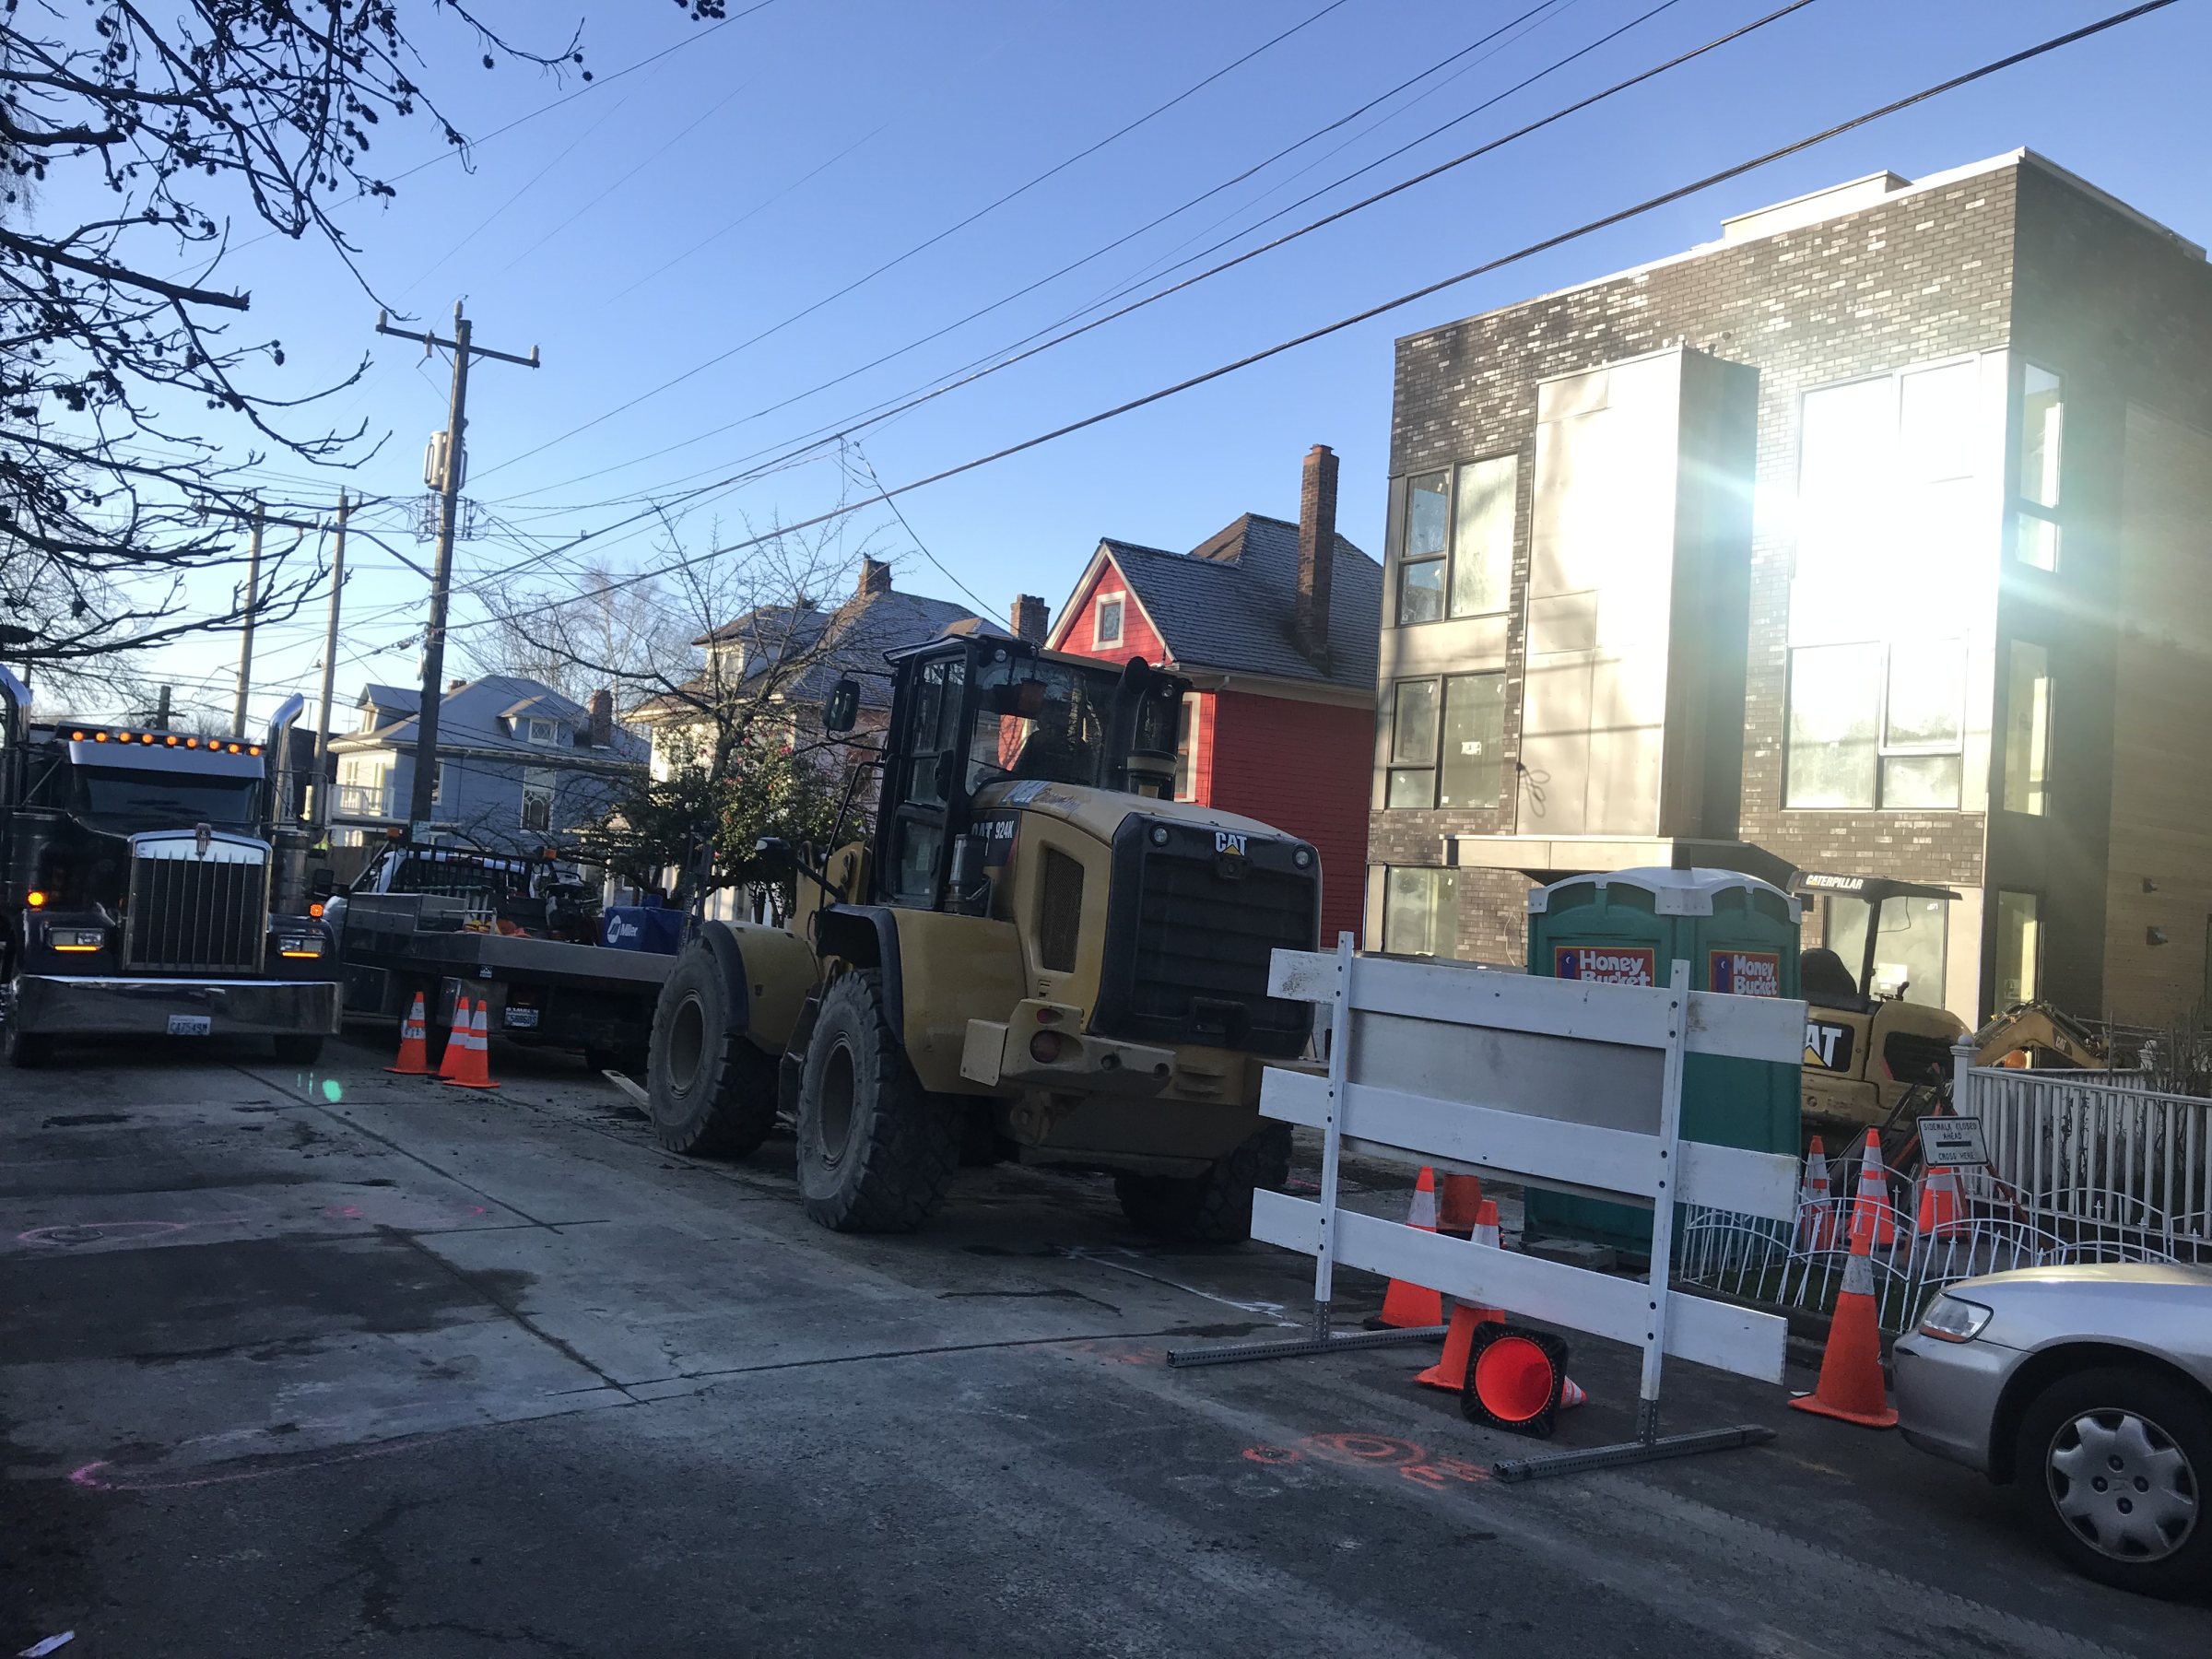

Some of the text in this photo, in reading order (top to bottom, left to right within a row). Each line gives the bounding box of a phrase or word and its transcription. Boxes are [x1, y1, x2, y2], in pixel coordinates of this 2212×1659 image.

[995, 820, 1014, 840] 924K
[1215, 831, 1248, 856] CAT
[1806, 875, 1864, 889] CATERPILLAR
[619, 924, 639, 937] Miller
[1579, 949, 1645, 976] Honey
[1733, 954, 1774, 981] Money
[1733, 975, 1778, 996] Bucket
[1806, 1024, 1842, 1067] AT
[2055, 1035, 2067, 1051] CAT
[1924, 1122, 1977, 1131] SIDEWALK CLOSED
[1943, 1132, 1962, 1140] AHEAD
[1938, 1151, 1975, 1160] CROSS HERE
